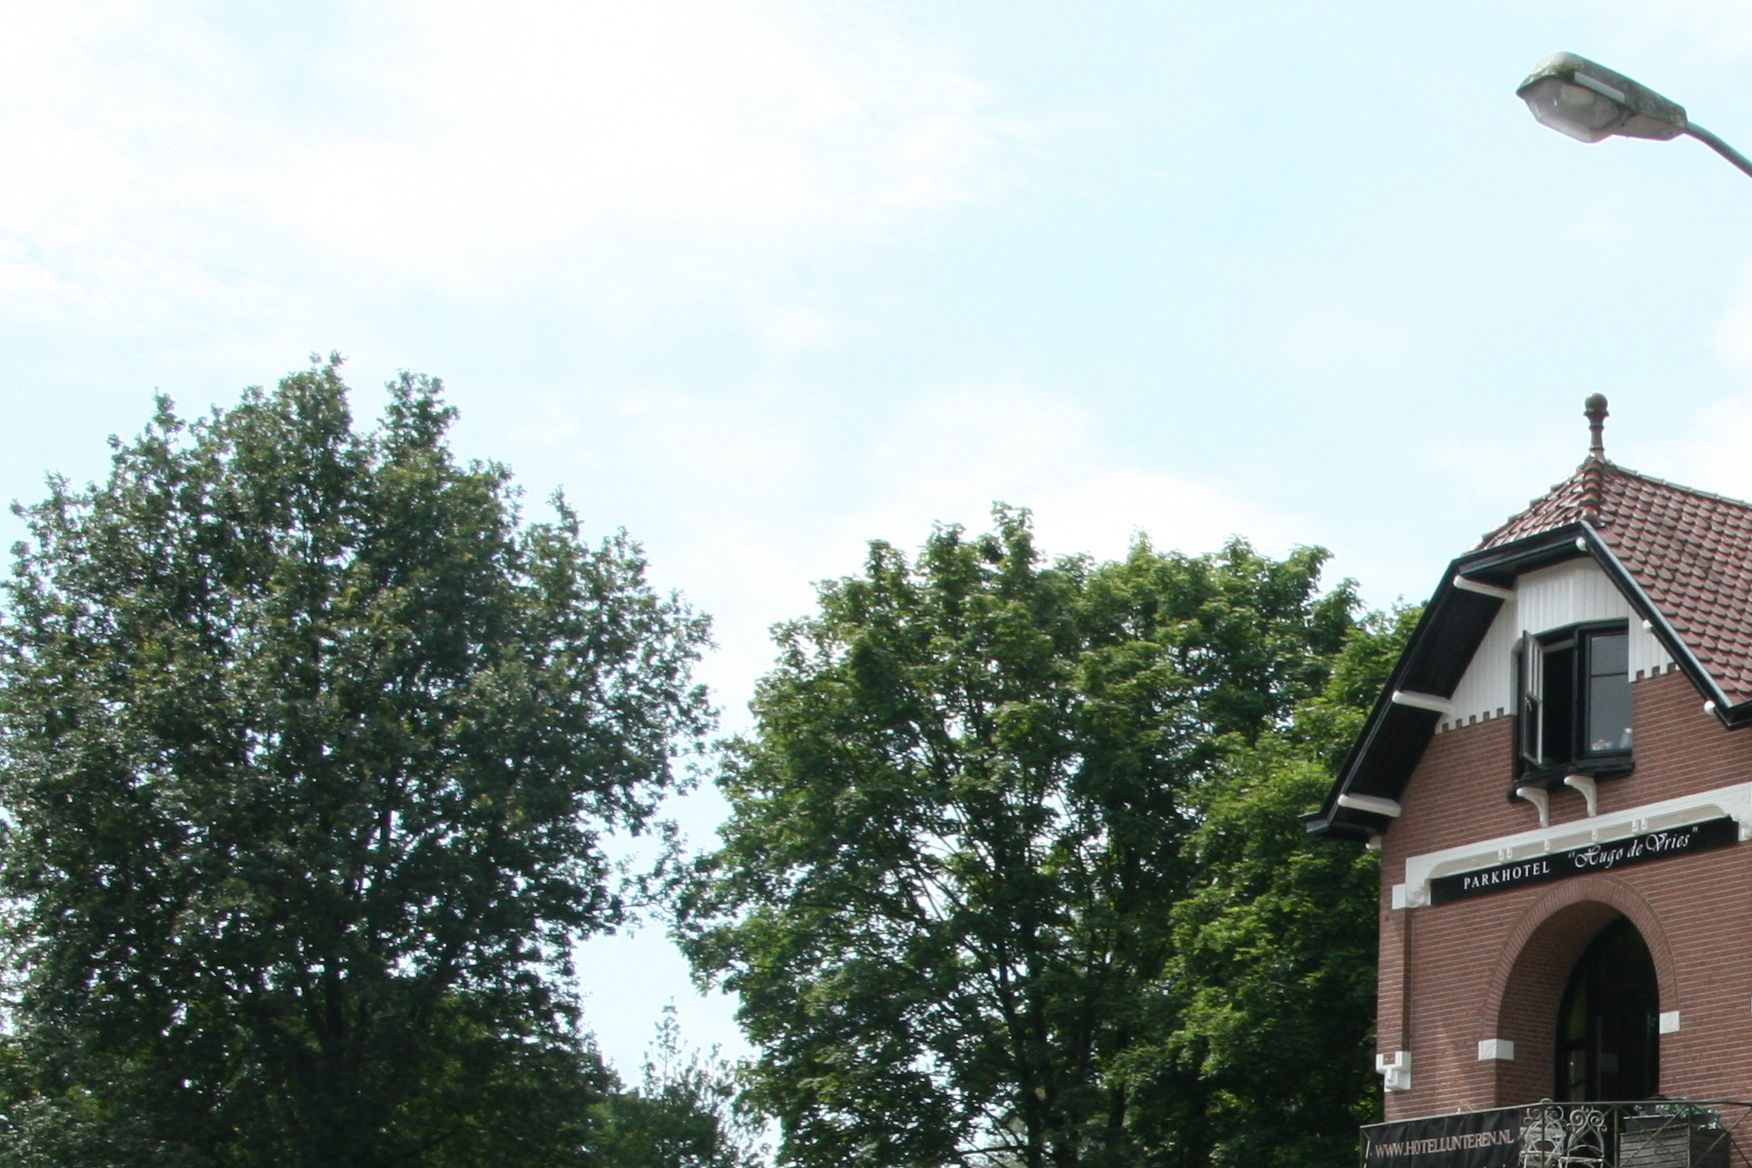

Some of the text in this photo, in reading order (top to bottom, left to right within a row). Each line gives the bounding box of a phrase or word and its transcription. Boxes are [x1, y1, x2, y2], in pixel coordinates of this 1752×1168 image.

[1463, 860, 1550, 890] PARKHOTEL
[1626, 839, 1644, 858] de
[1374, 1128, 1515, 1159] WWW.HOTELLUNTEREN.NL
